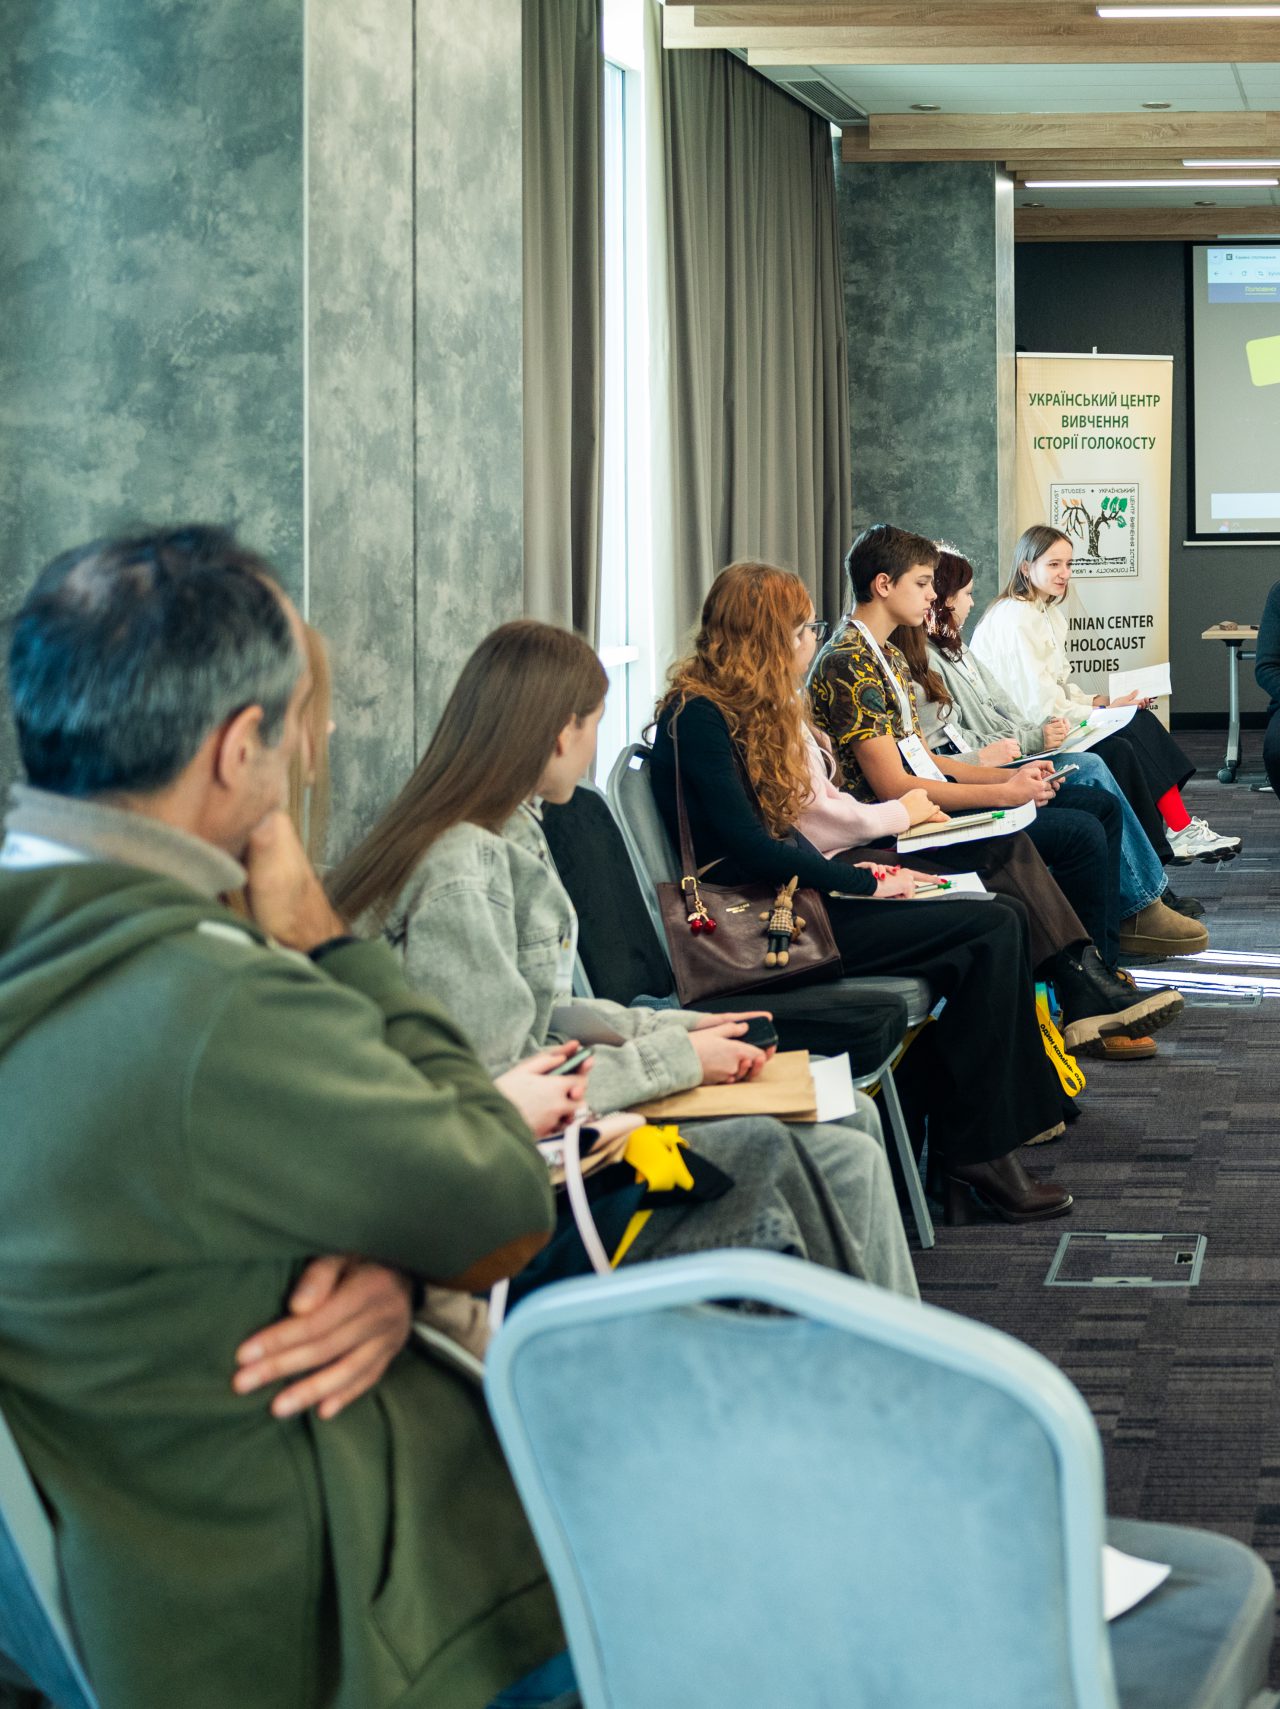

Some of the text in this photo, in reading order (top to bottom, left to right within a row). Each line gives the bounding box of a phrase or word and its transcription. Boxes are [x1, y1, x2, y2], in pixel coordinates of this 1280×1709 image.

[1029, 390, 1160, 409] УКРАЇНСЬКИЙ ЦЕНТР
[1061, 415, 1129, 428] ВИВЧЕННЯ
[1033, 434, 1156, 450] ІСТОРІЇ ГОЛОКОСТУ
[1068, 615, 1154, 631] INIAN CENTER
[1071, 636, 1146, 652] HOLOCAUST
[1070, 659, 1119, 674] STUDIES
[1040, 1024, 1055, 1046] один
